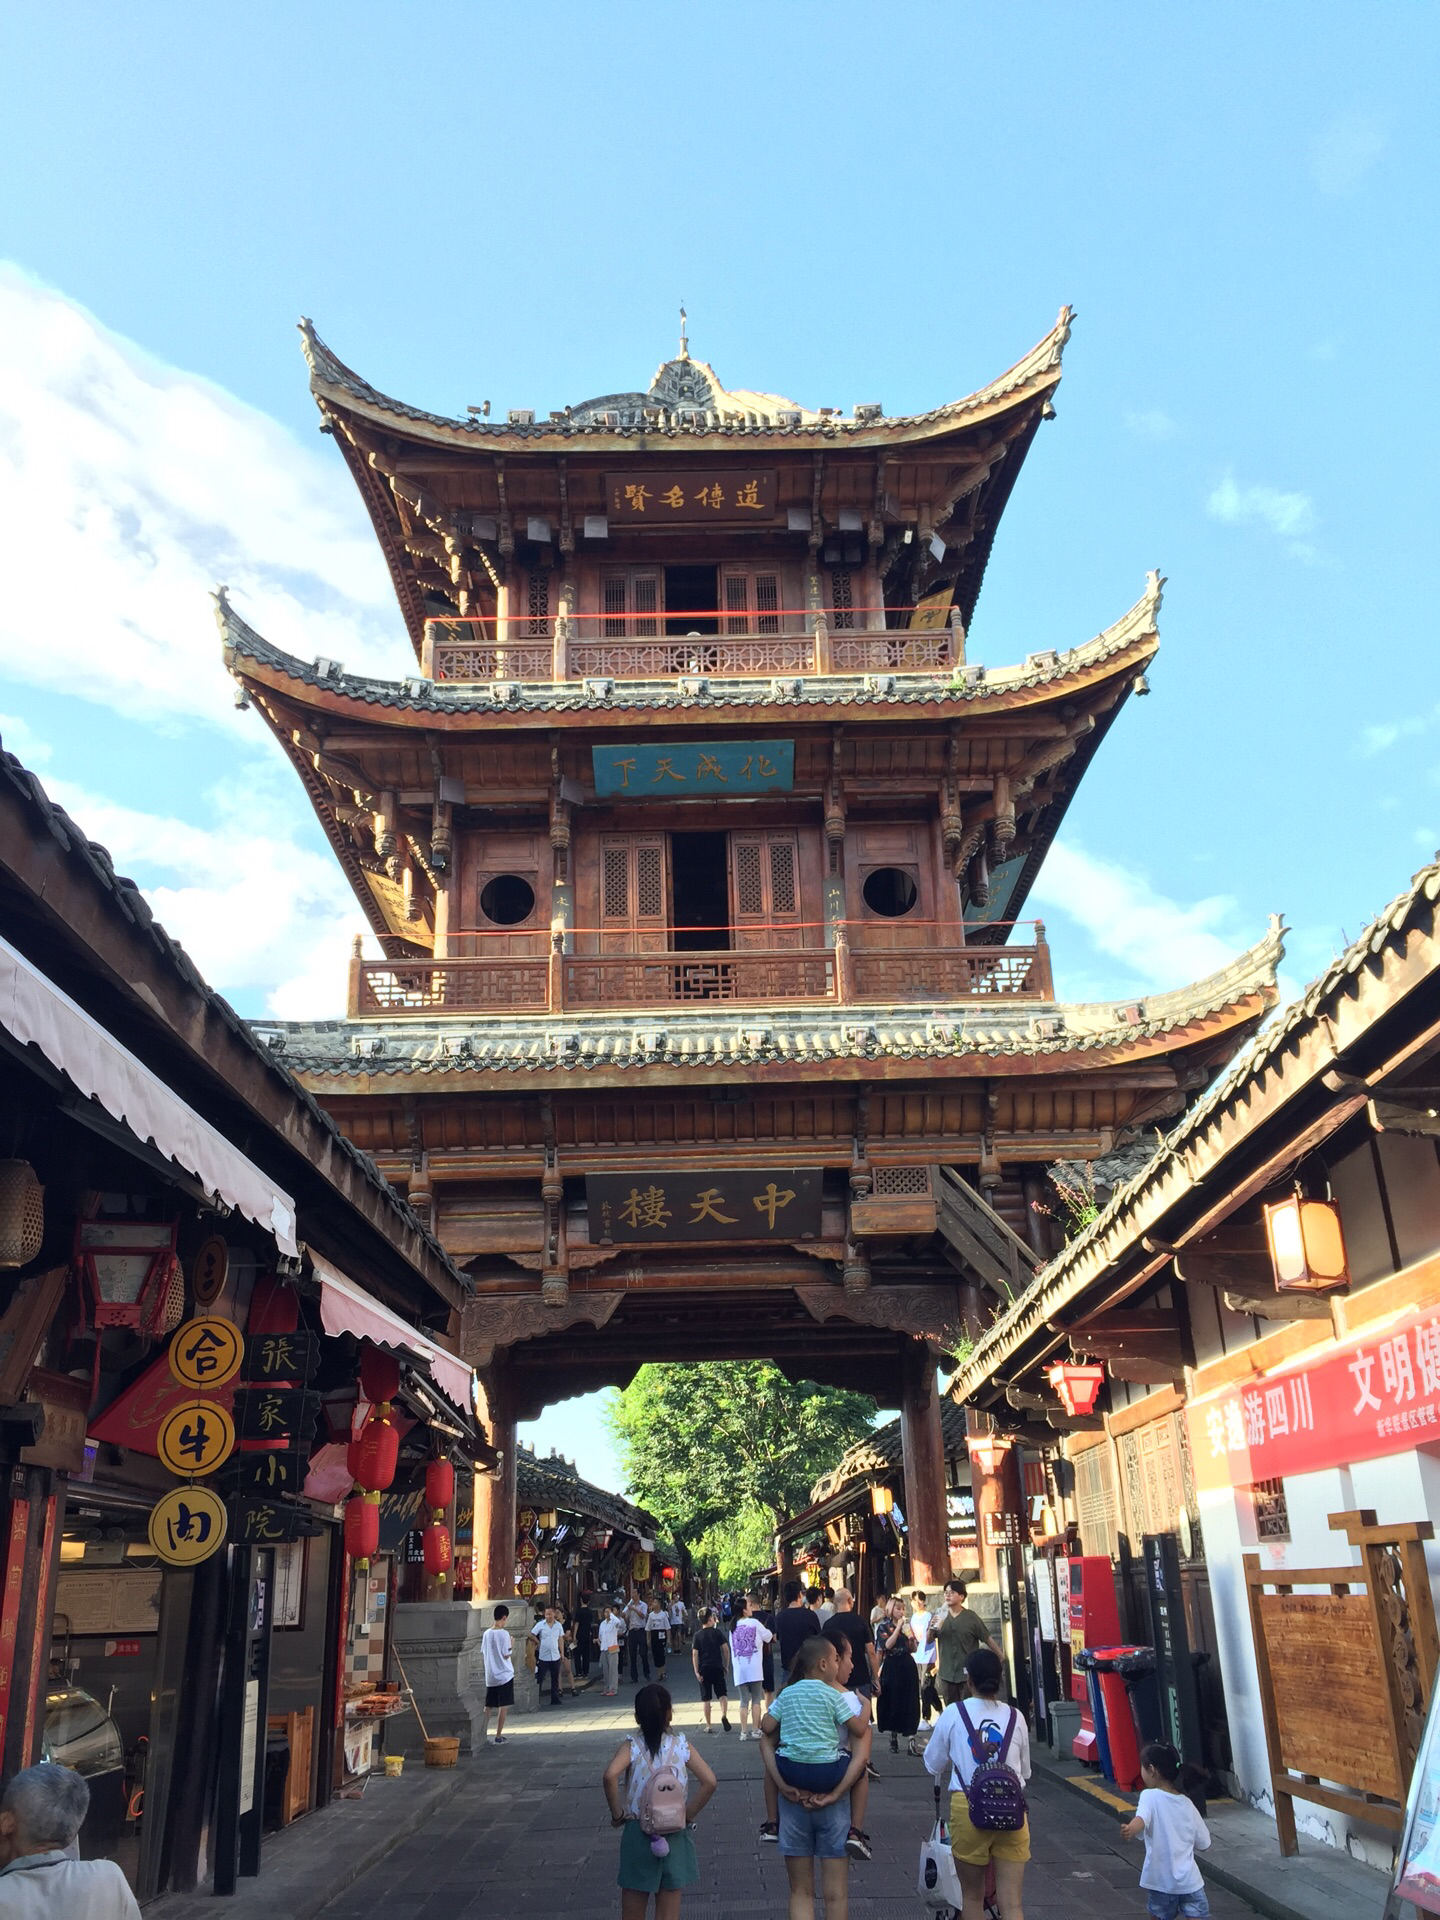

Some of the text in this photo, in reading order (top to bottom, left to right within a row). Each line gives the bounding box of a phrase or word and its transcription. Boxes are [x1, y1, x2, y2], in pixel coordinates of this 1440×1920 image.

[1205, 1373, 1314, 1458] 安逸游四川
[520, 1511, 534, 1595] 野生菌
